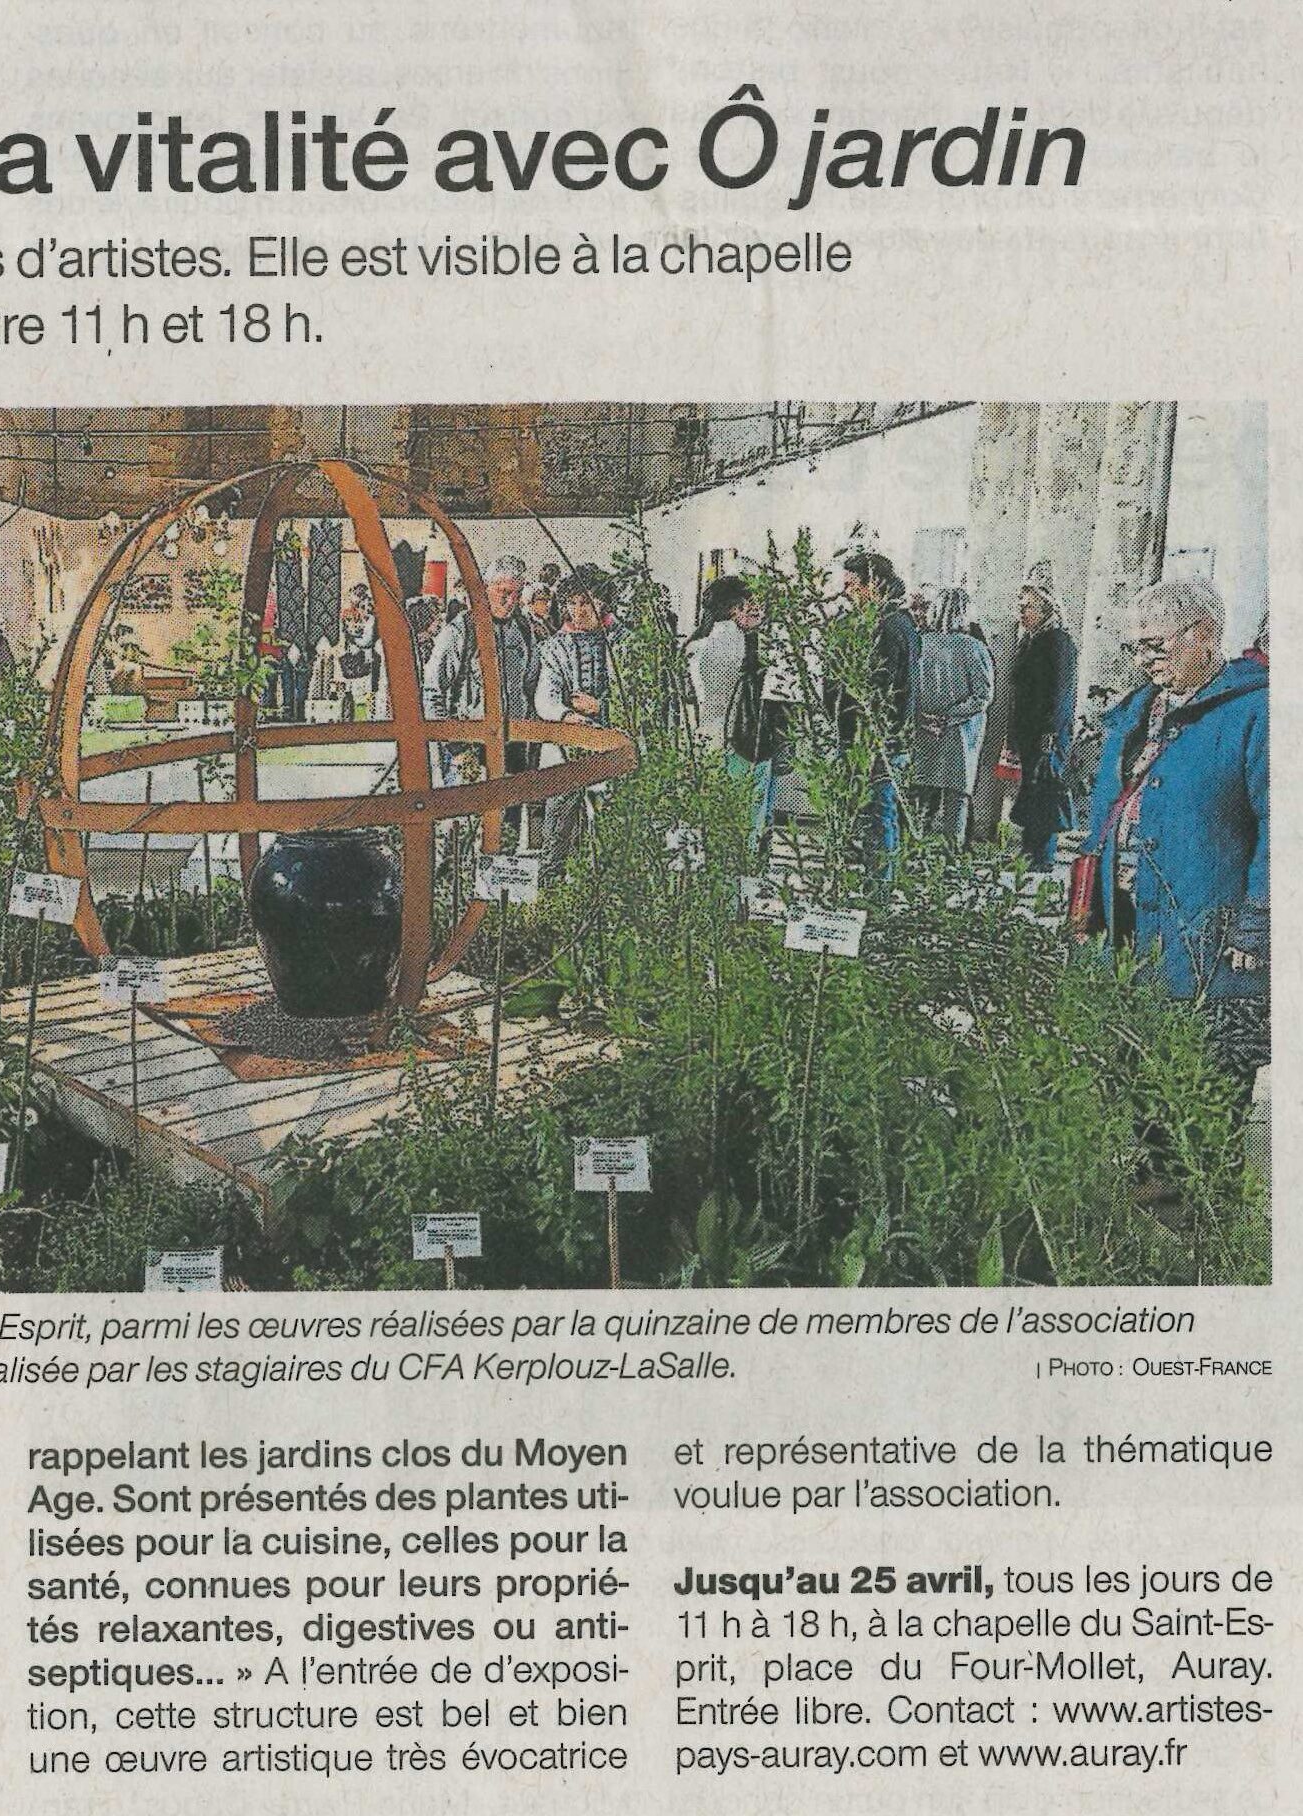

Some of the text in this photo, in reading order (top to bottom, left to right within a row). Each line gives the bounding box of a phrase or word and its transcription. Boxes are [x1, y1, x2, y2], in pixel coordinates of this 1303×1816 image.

[74, 107, 409, 194] vitalité
[434, 127, 669, 193] avec
[698, 83, 779, 190] Ô
[787, 103, 1086, 211] jardin
[16, 237, 231, 279] d'artistes.
[249, 236, 329, 277] Elle
[341, 237, 408, 277] est
[417, 234, 561, 276] visible
[572, 232, 600, 275] à
[613, 233, 650, 274] la
[660, 231, 852, 283] chapelle
[61, 304, 112, 345] 11
[123, 303, 149, 344] h
[162, 305, 204, 344] et
[219, 303, 271, 343] 18
[285, 302, 322, 343] h.
[100, 1311, 191, 1346] parmi
[197, 1311, 241, 1339] les
[248, 1317, 362, 1339] œuvres
[369, 1309, 505, 1338] réalisées
[510, 1315, 566, 1343] par
[570, 1309, 596, 1337] la
[604, 1307, 751, 1343] quinzaine
[758, 1307, 798, 1335] de
[805, 1306, 952, 1335] membres
[959, 1306, 999, 1334] de
[1006, 1305, 1195, 1334] l'association
[86, 1361, 141, 1387] par
[145, 1355, 188, 1383] les
[195, 1354, 343, 1389] stagiaires
[350, 1353, 390, 1382] du
[398, 1352, 464, 1381] CFA
[473, 1351, 735, 1386] Kerplouz-LaSalle.
[29, 1437, 627, 1477] rappelant les jardins clos du Moyen
[674, 1433, 1273, 1472] et représentative de la thématique
[677, 1695, 779, 1725] Entrée
[796, 1696, 871, 1725] libre.
[887, 1694, 1015, 1725] Contact
[1052, 1693, 1273, 1724] www.artistes-
[30, 1740, 628, 1774] une œuvre artistique très évocatrice
[676, 1737, 1188, 1776] pays-auray.com et www.auray.fr
